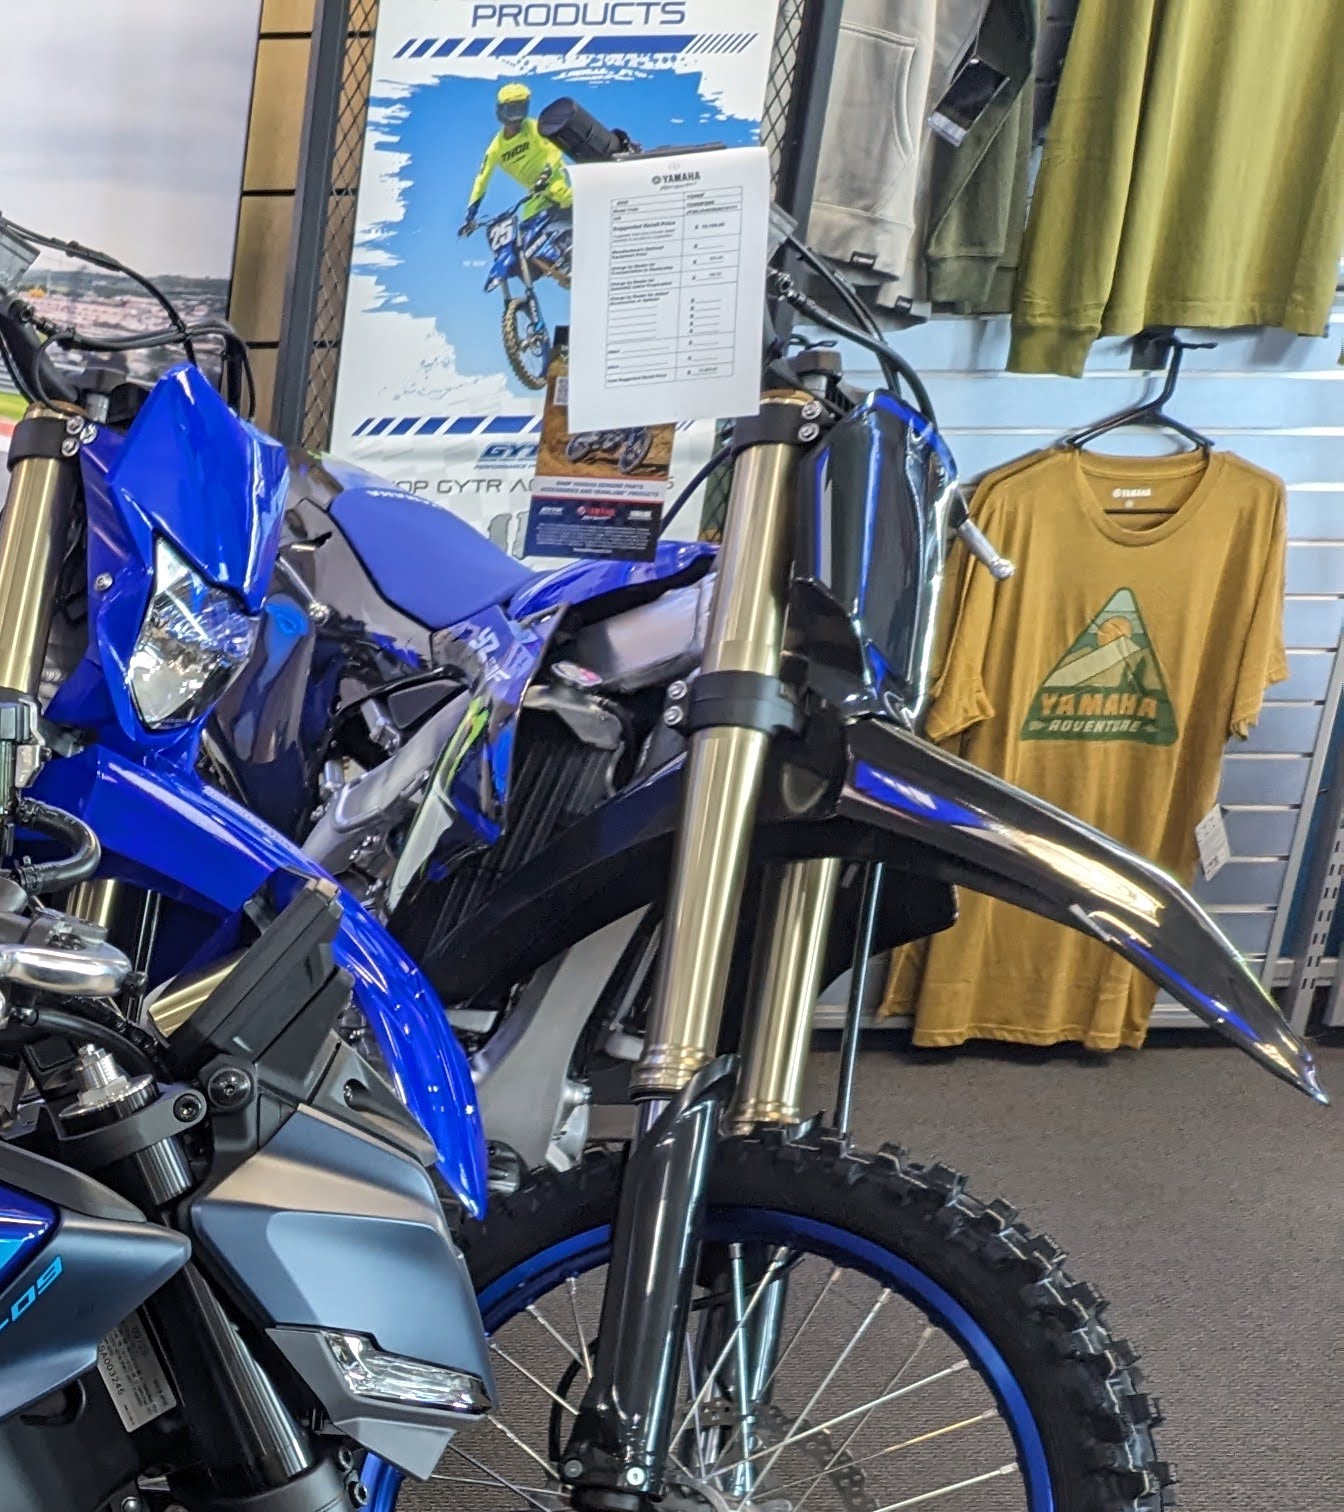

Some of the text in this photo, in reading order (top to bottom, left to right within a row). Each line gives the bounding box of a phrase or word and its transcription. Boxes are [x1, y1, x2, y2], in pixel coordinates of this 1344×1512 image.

[470, 0, 687, 28] PRODUCTS
[499, 142, 530, 162] THOR
[662, 171, 701, 183] YAMAHA
[436, 479, 503, 495] GYTR
[1041, 692, 1158, 719] YAMAHA
[1048, 719, 1142, 733] ADVENTURE
